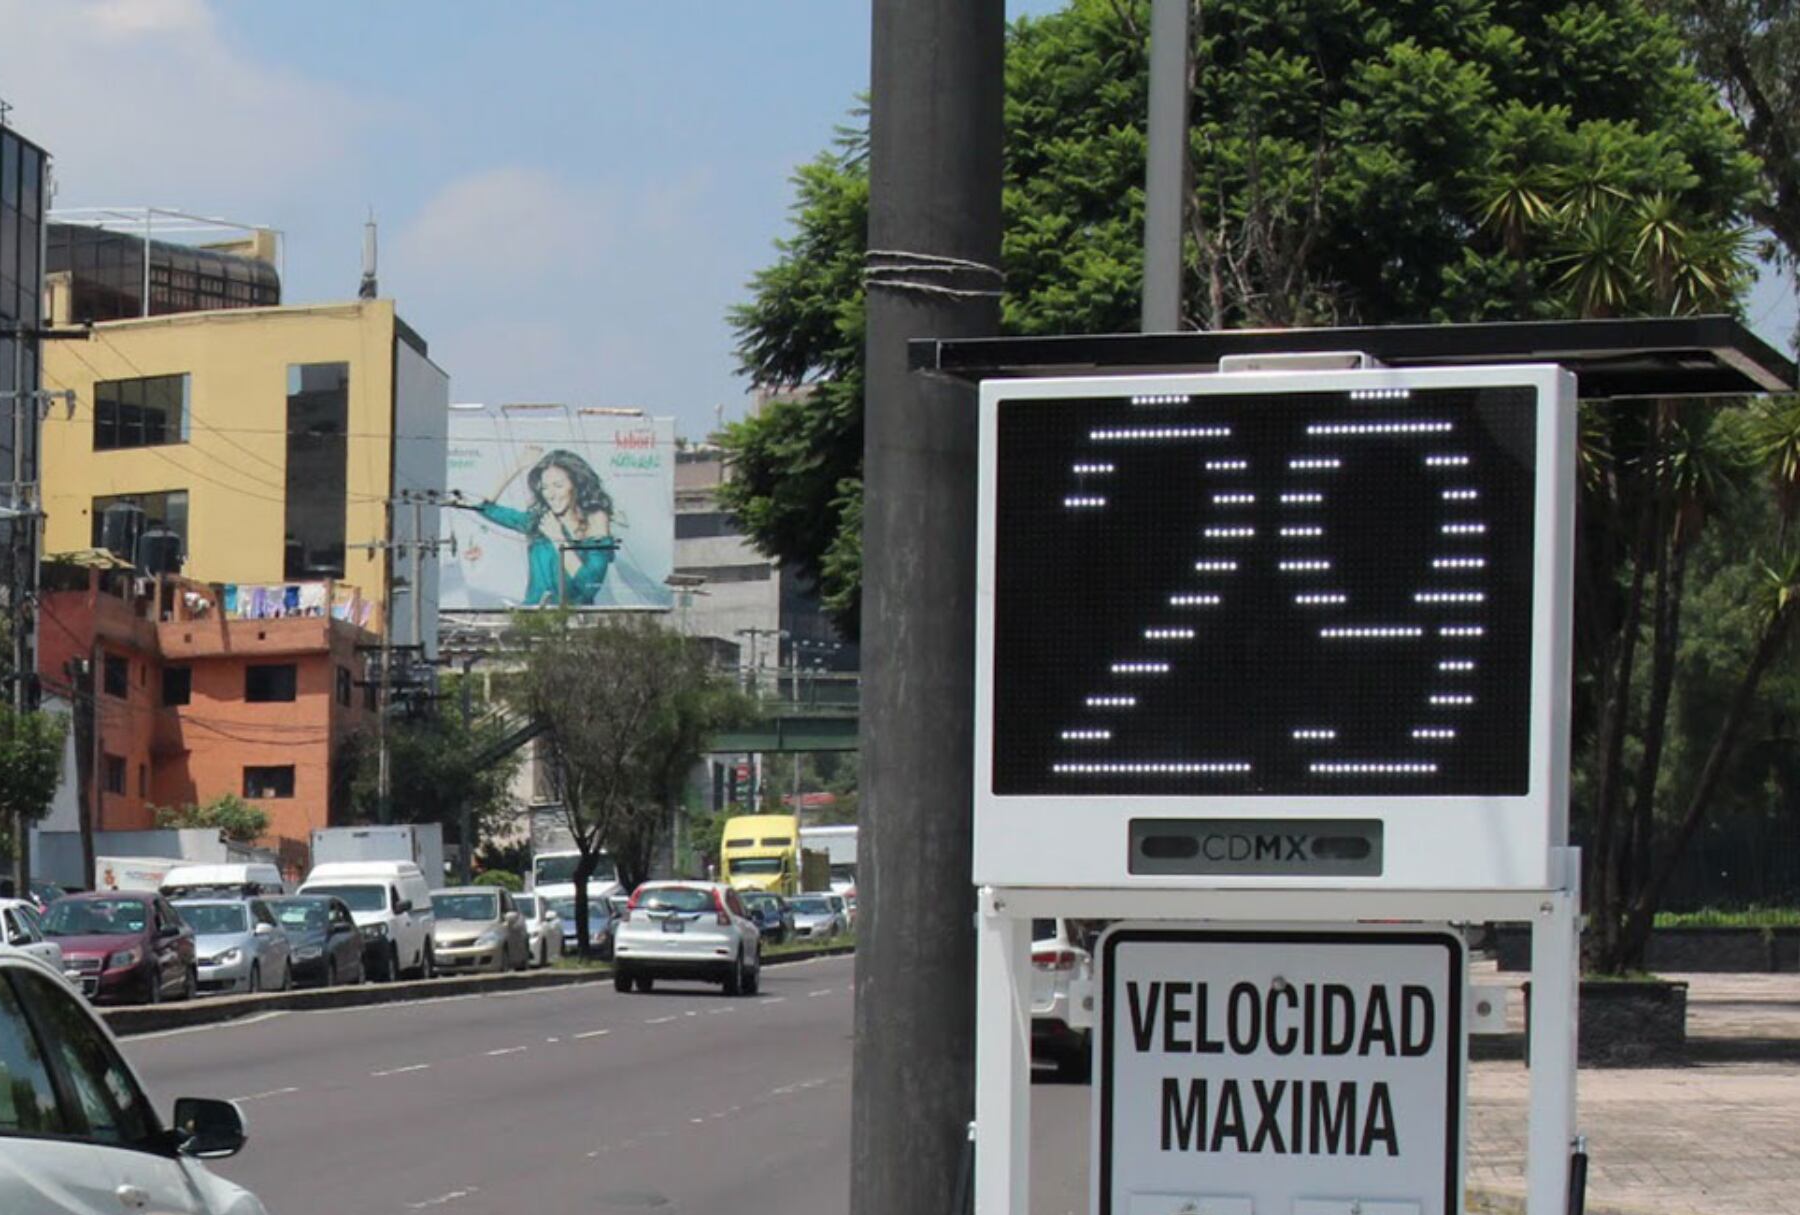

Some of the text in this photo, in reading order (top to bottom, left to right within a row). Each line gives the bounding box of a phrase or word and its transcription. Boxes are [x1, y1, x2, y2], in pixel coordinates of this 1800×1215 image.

[1203, 834, 1308, 861] CDMX
[1126, 981, 1434, 1057] VELOCIDAD
[1161, 1078, 1400, 1156] MAXIMA
